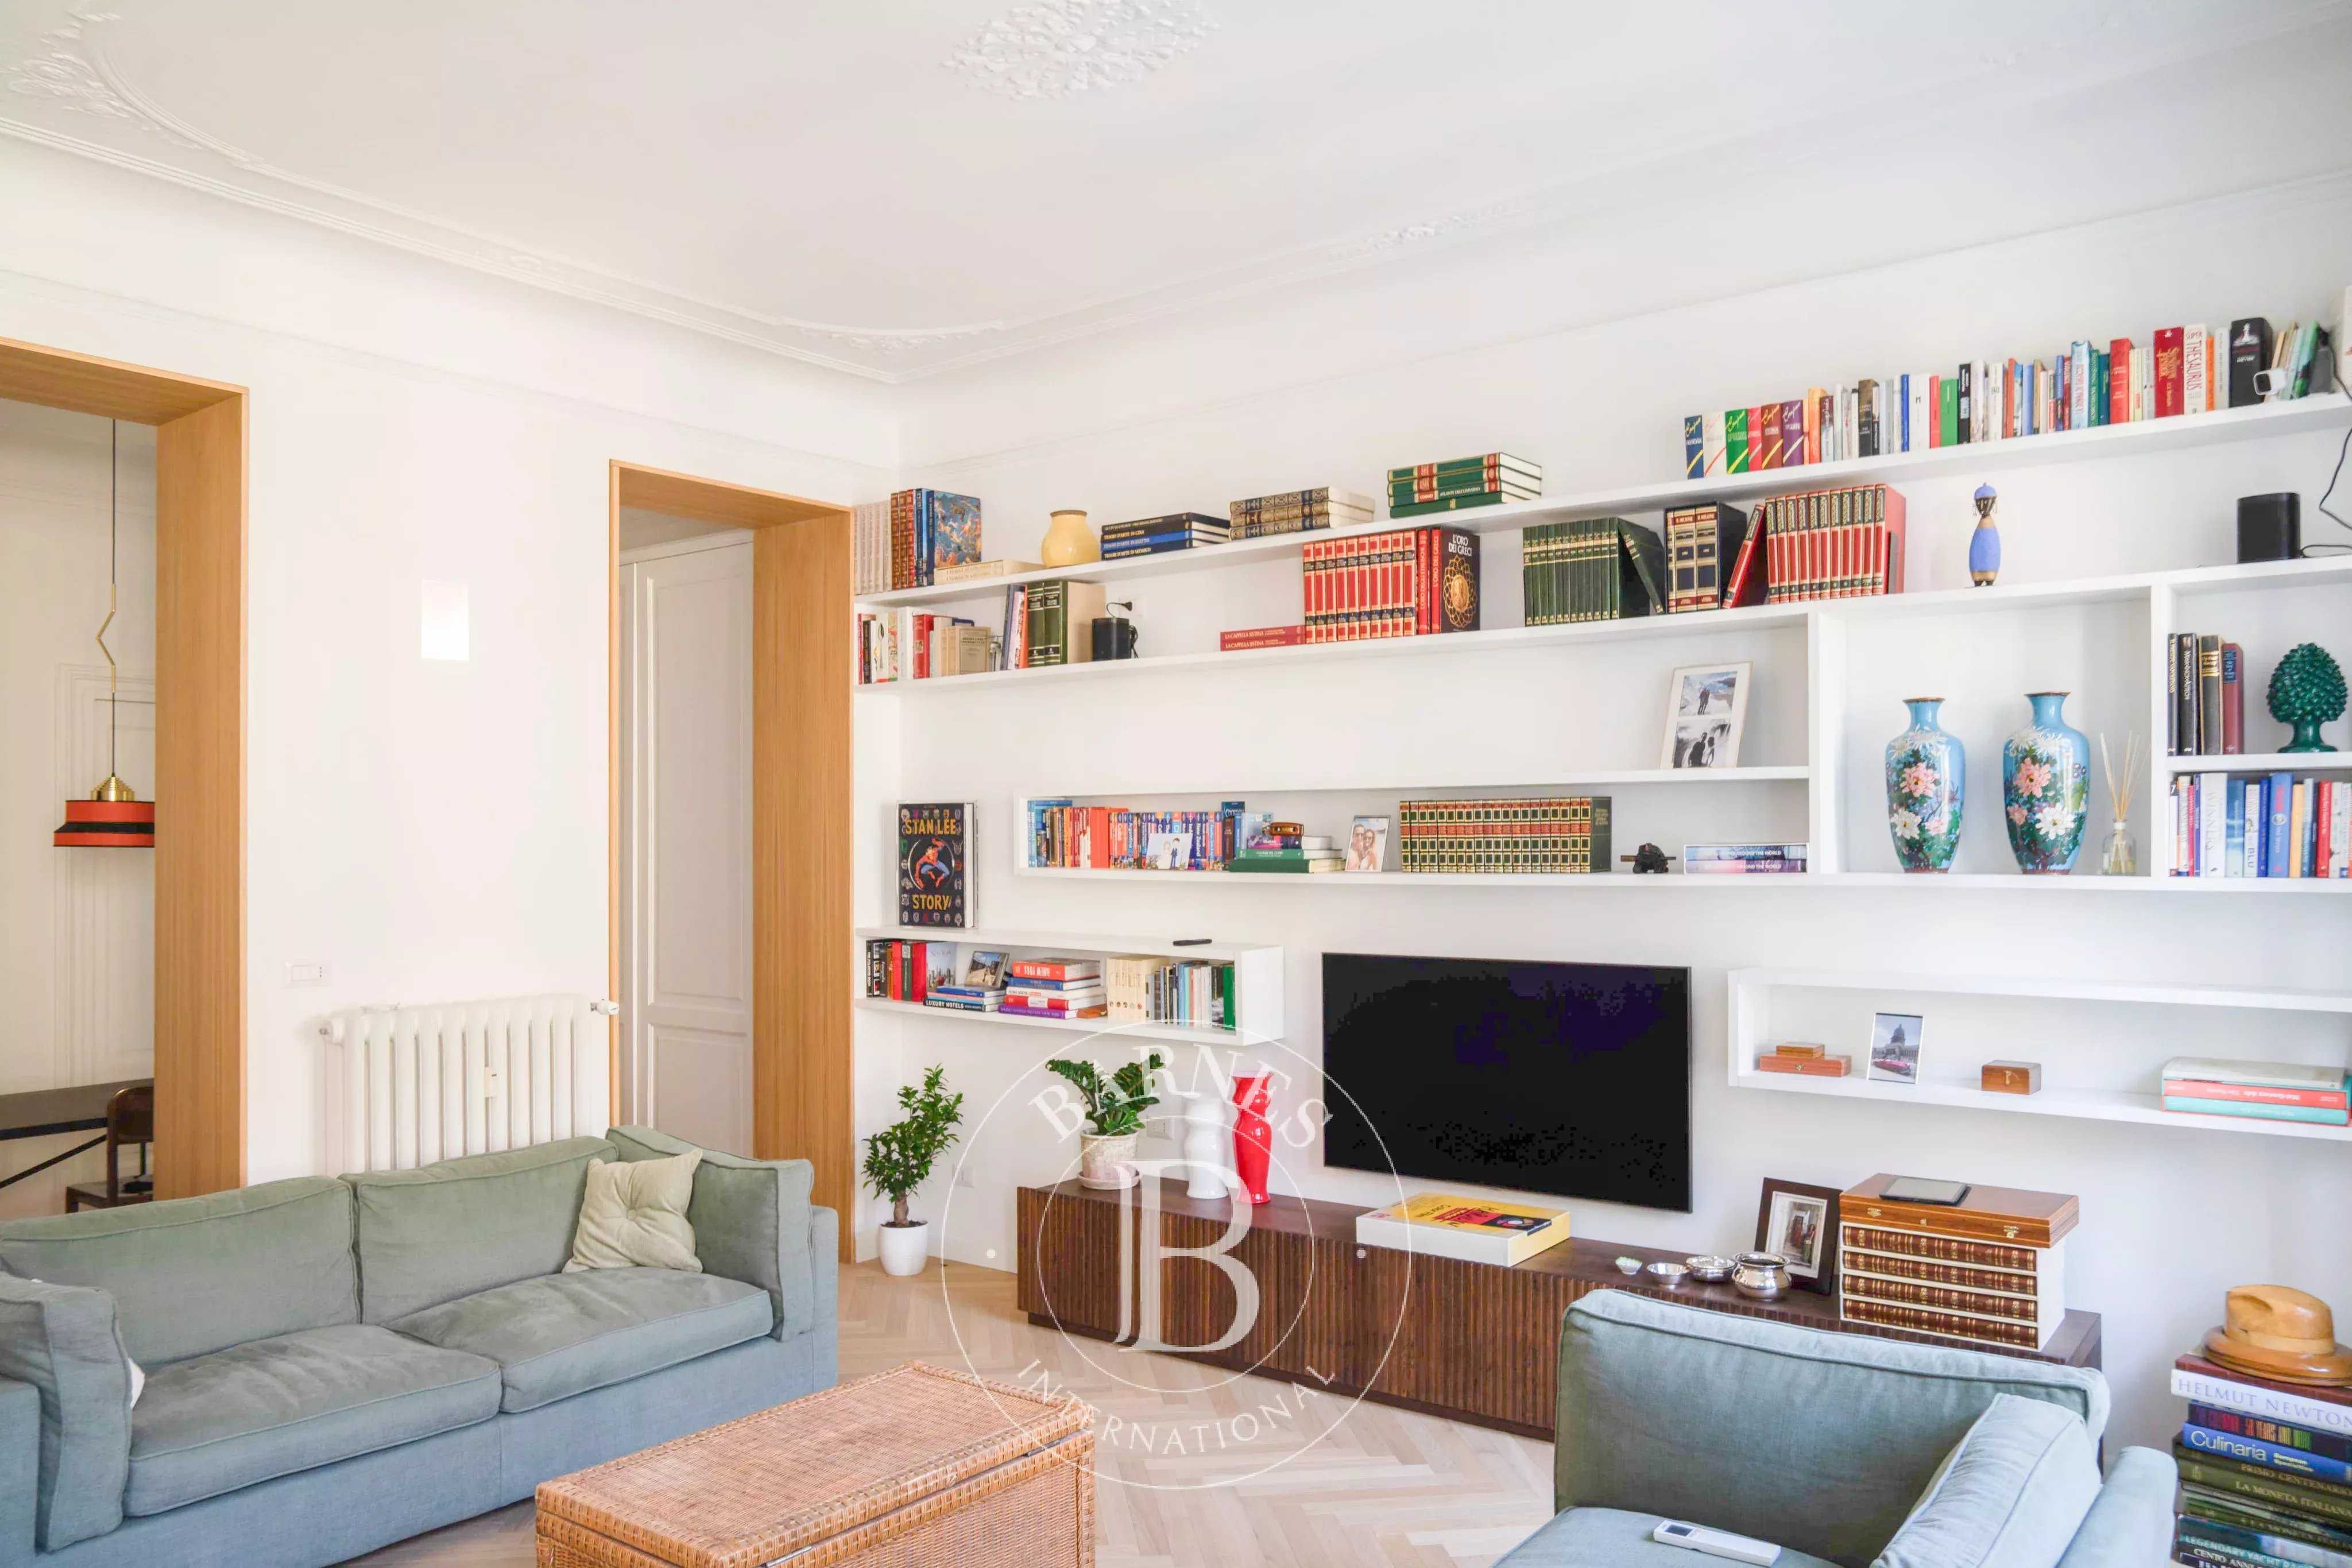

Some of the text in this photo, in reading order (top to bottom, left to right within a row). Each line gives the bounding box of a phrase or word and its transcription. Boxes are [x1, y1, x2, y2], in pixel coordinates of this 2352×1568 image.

[2186, 331, 2202, 391] SUPER THESAURUS
[1449, 542, 1472, 556] DEI GRECI
[1453, 533, 1468, 546] L'ORO
[904, 817, 957, 836] STAN LEE
[2247, 847, 2255, 868] BLU
[911, 893, 949, 911] STORY
[926, 1000, 964, 1009] LUXURY HOTELS
[2178, 1378, 2257, 1407] HELMUT
[2190, 1430, 2268, 1462] Culinaria
[2235, 1481, 2249, 1491] LA
[2252, 1484, 2298, 1504] MONETA
[2194, 1548, 2228, 1563] CENTO
